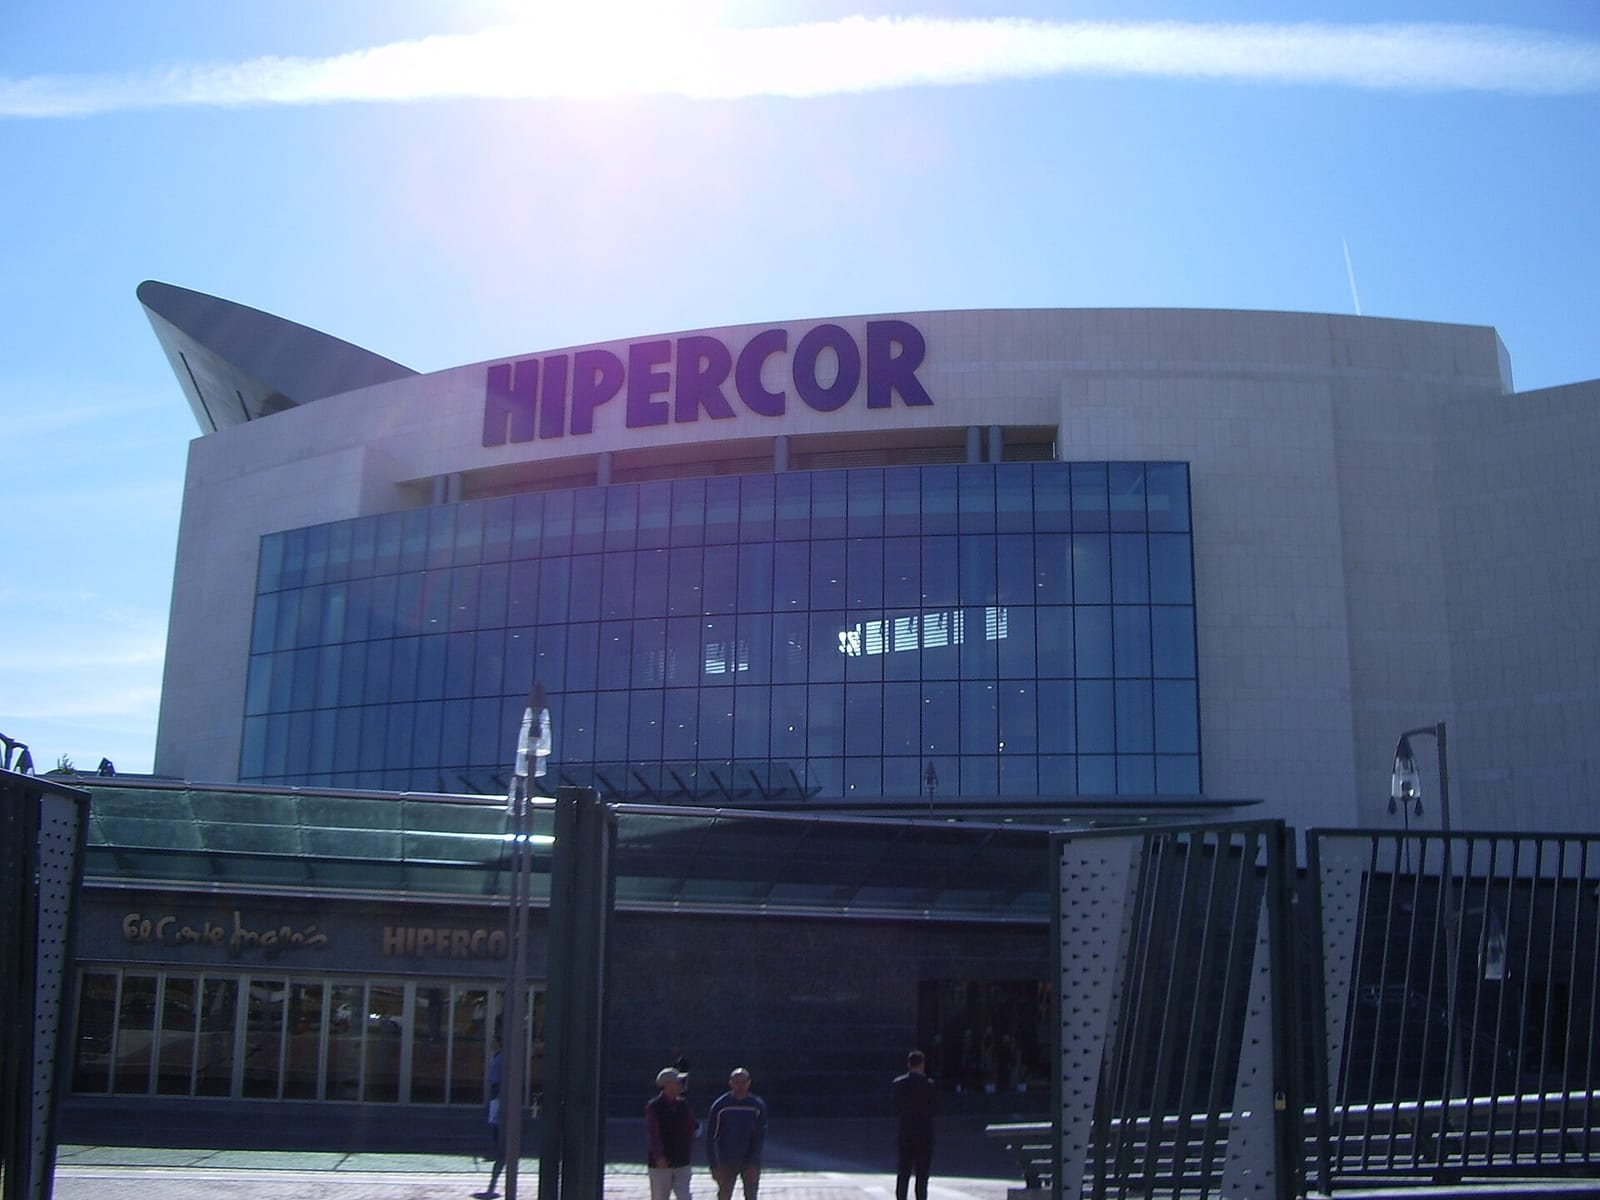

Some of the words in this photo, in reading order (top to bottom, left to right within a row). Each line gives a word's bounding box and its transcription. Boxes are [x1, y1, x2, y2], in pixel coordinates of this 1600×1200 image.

[482, 320, 933, 447] HIPERCOR
[123, 913, 151, 941] El
[383, 927, 507, 958] HIPERCO
